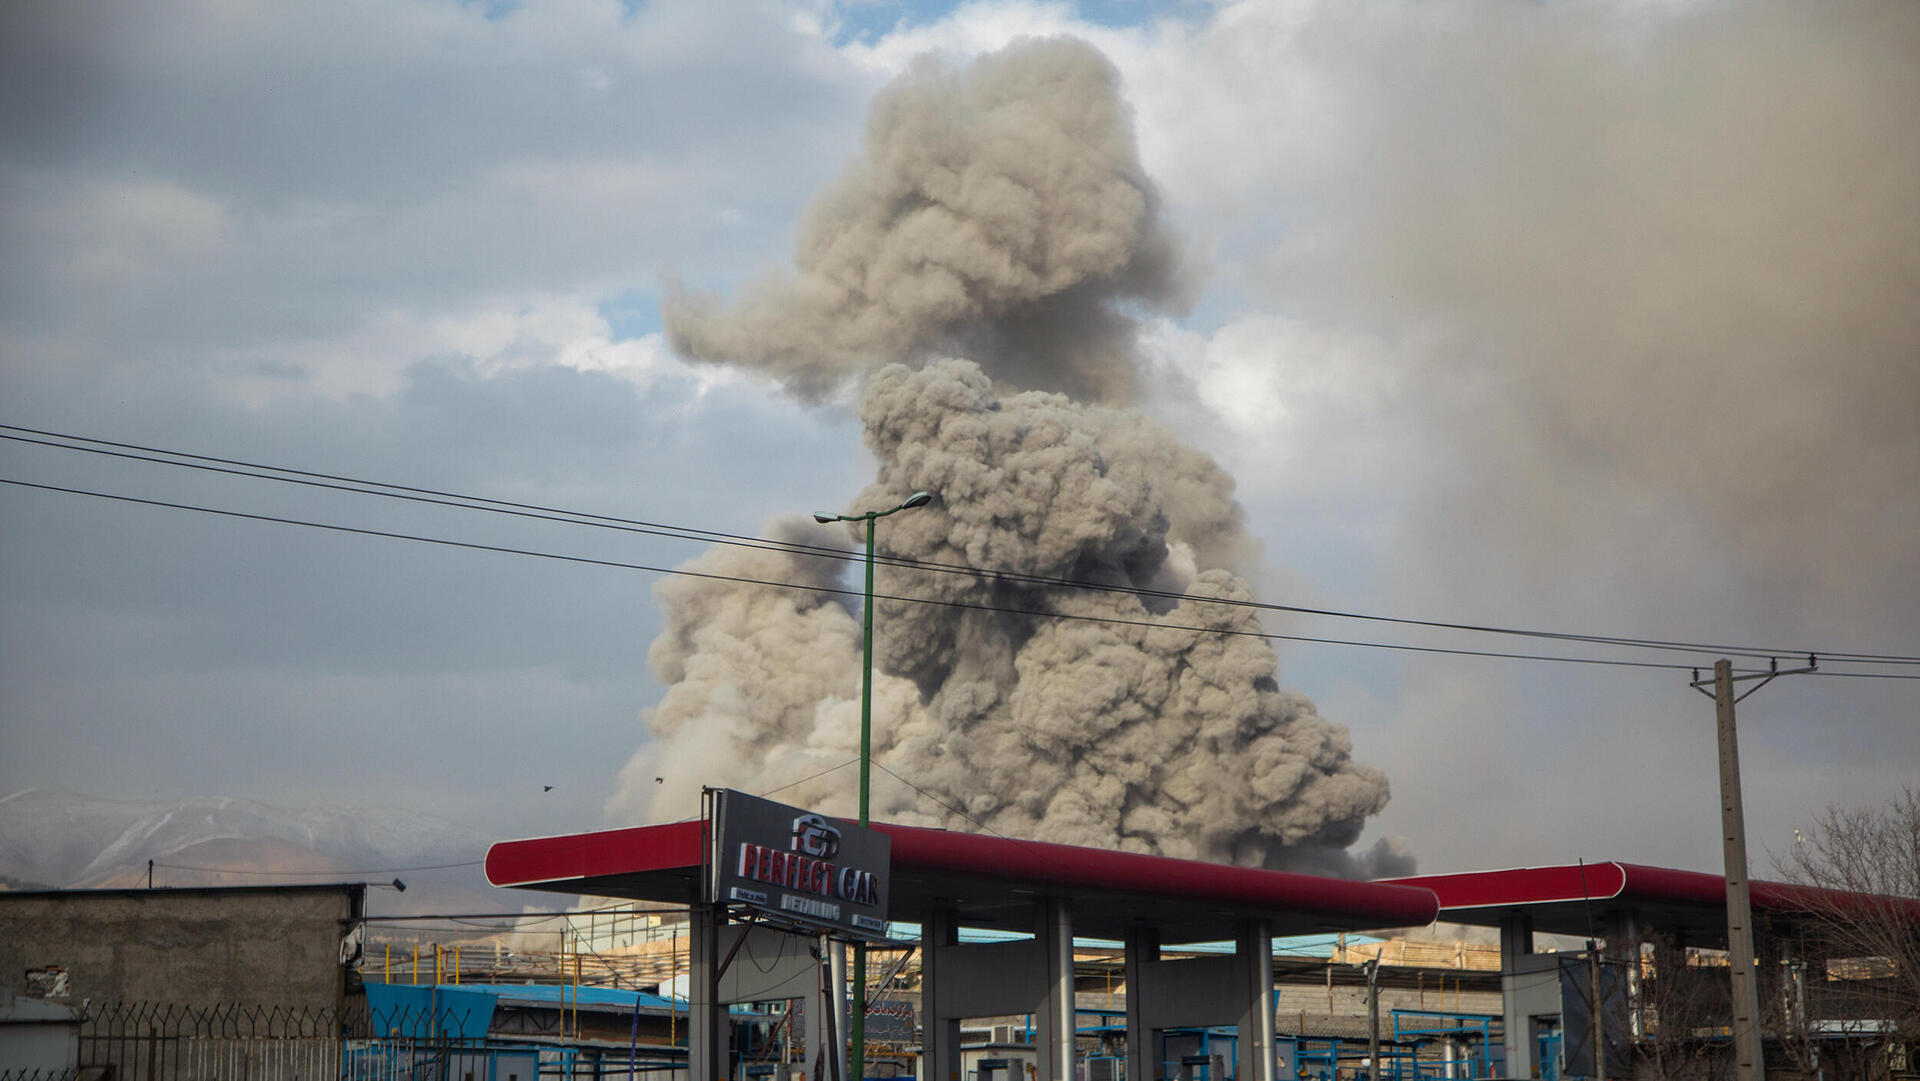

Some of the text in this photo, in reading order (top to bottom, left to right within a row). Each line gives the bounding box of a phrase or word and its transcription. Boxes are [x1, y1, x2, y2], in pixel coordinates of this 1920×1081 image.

[738, 842, 878, 905] PERFECT CAR
[781, 894, 840, 920] DETAILING
